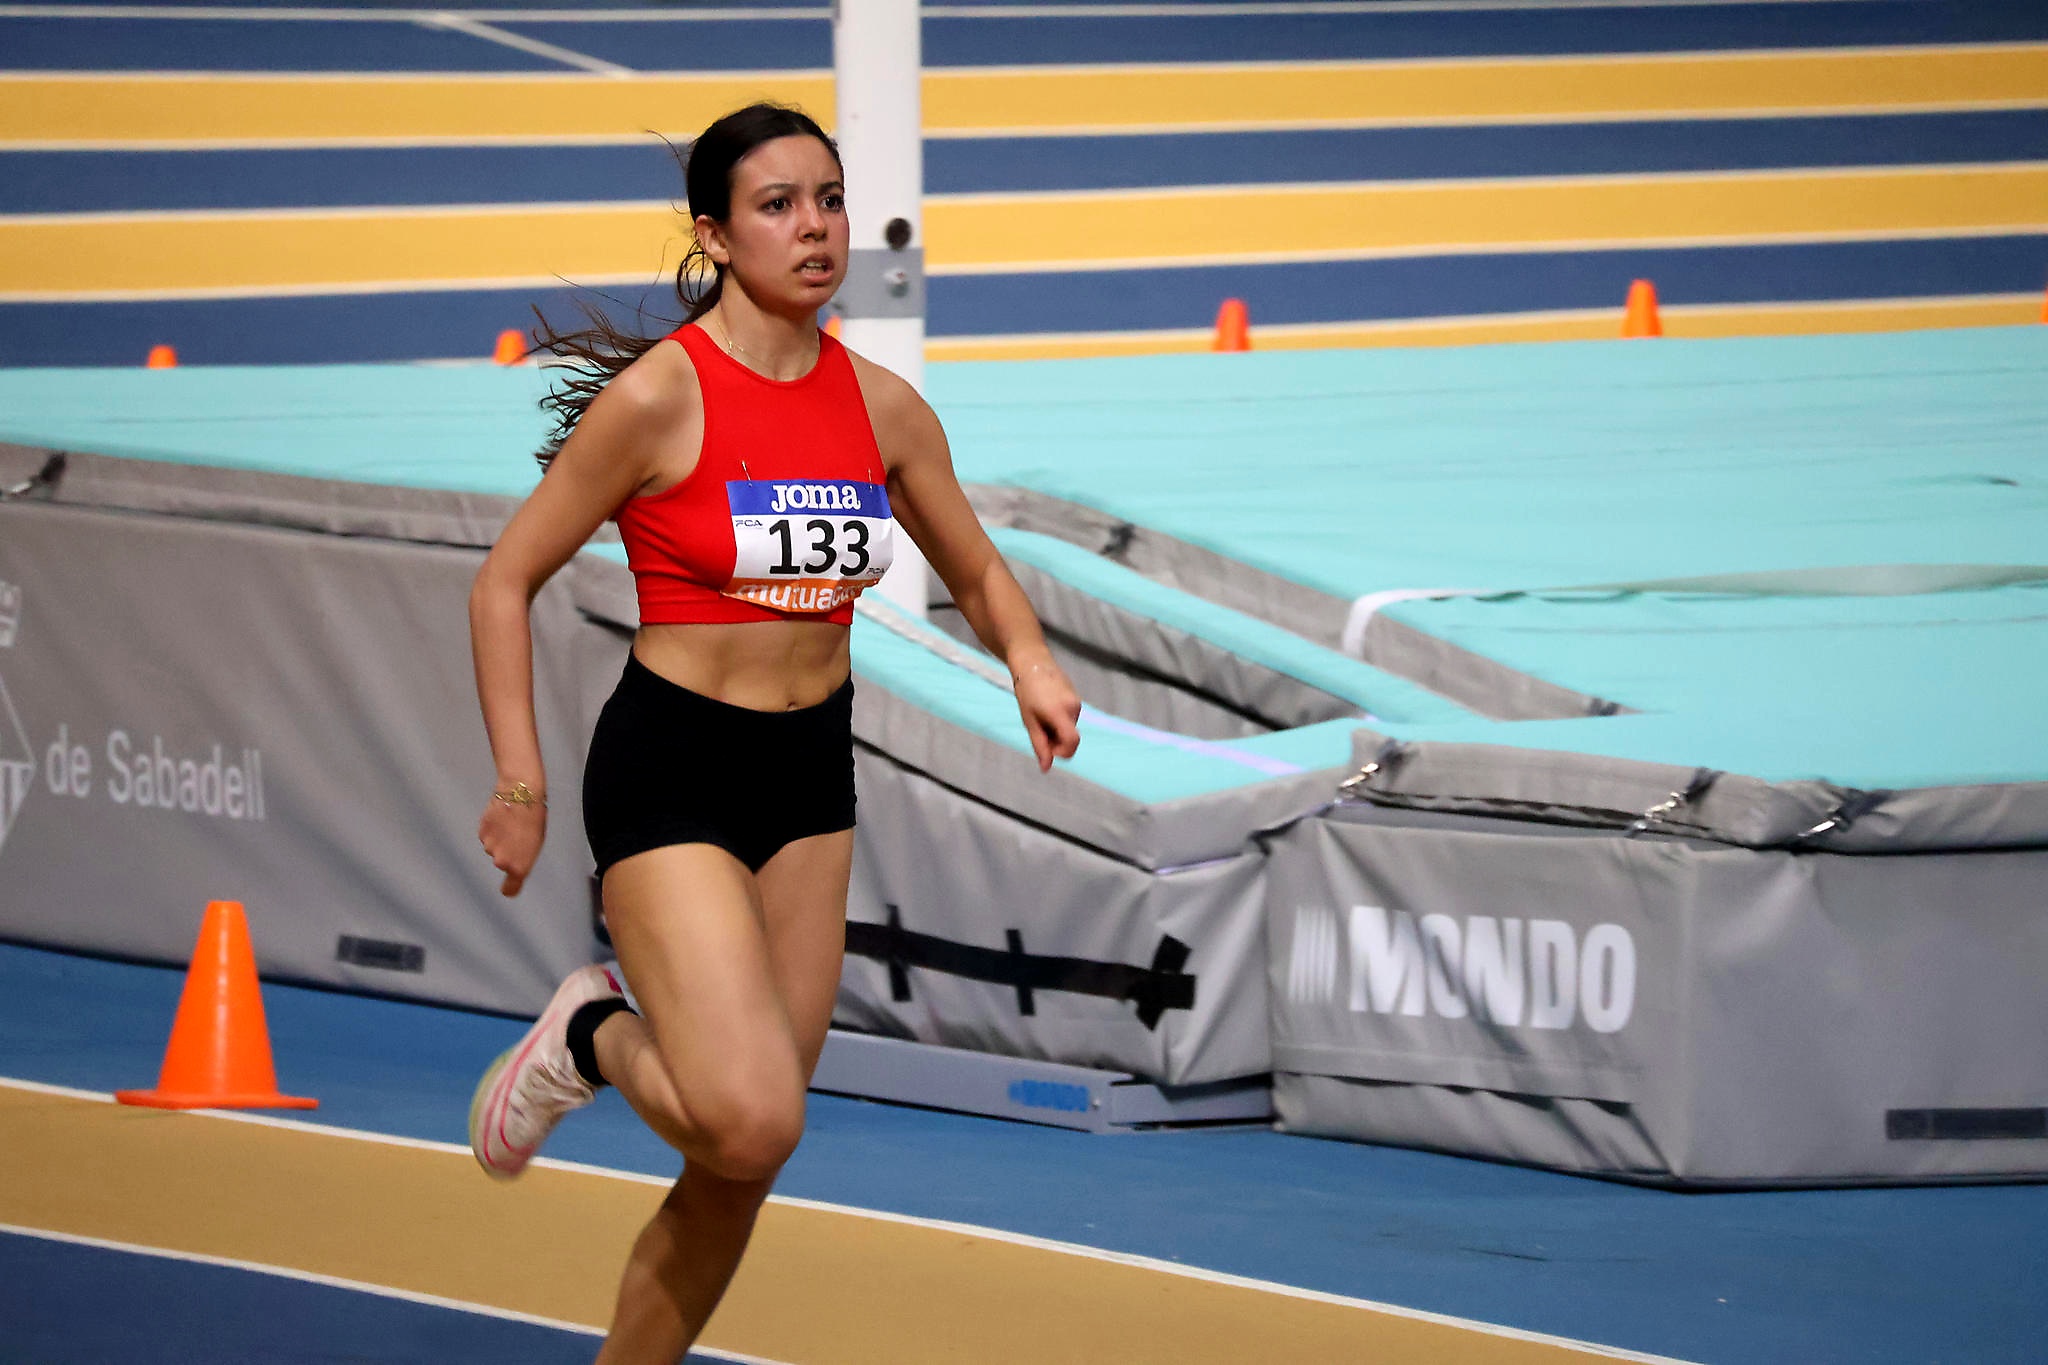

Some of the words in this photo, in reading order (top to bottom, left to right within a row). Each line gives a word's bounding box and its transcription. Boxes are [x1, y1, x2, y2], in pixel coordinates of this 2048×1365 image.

[735, 519, 763, 527] FCA
[769, 519, 870, 576] 133
[46, 723, 91, 798] de
[106, 729, 265, 821] Sabadell
[1349, 905, 1636, 1033] MONDO
